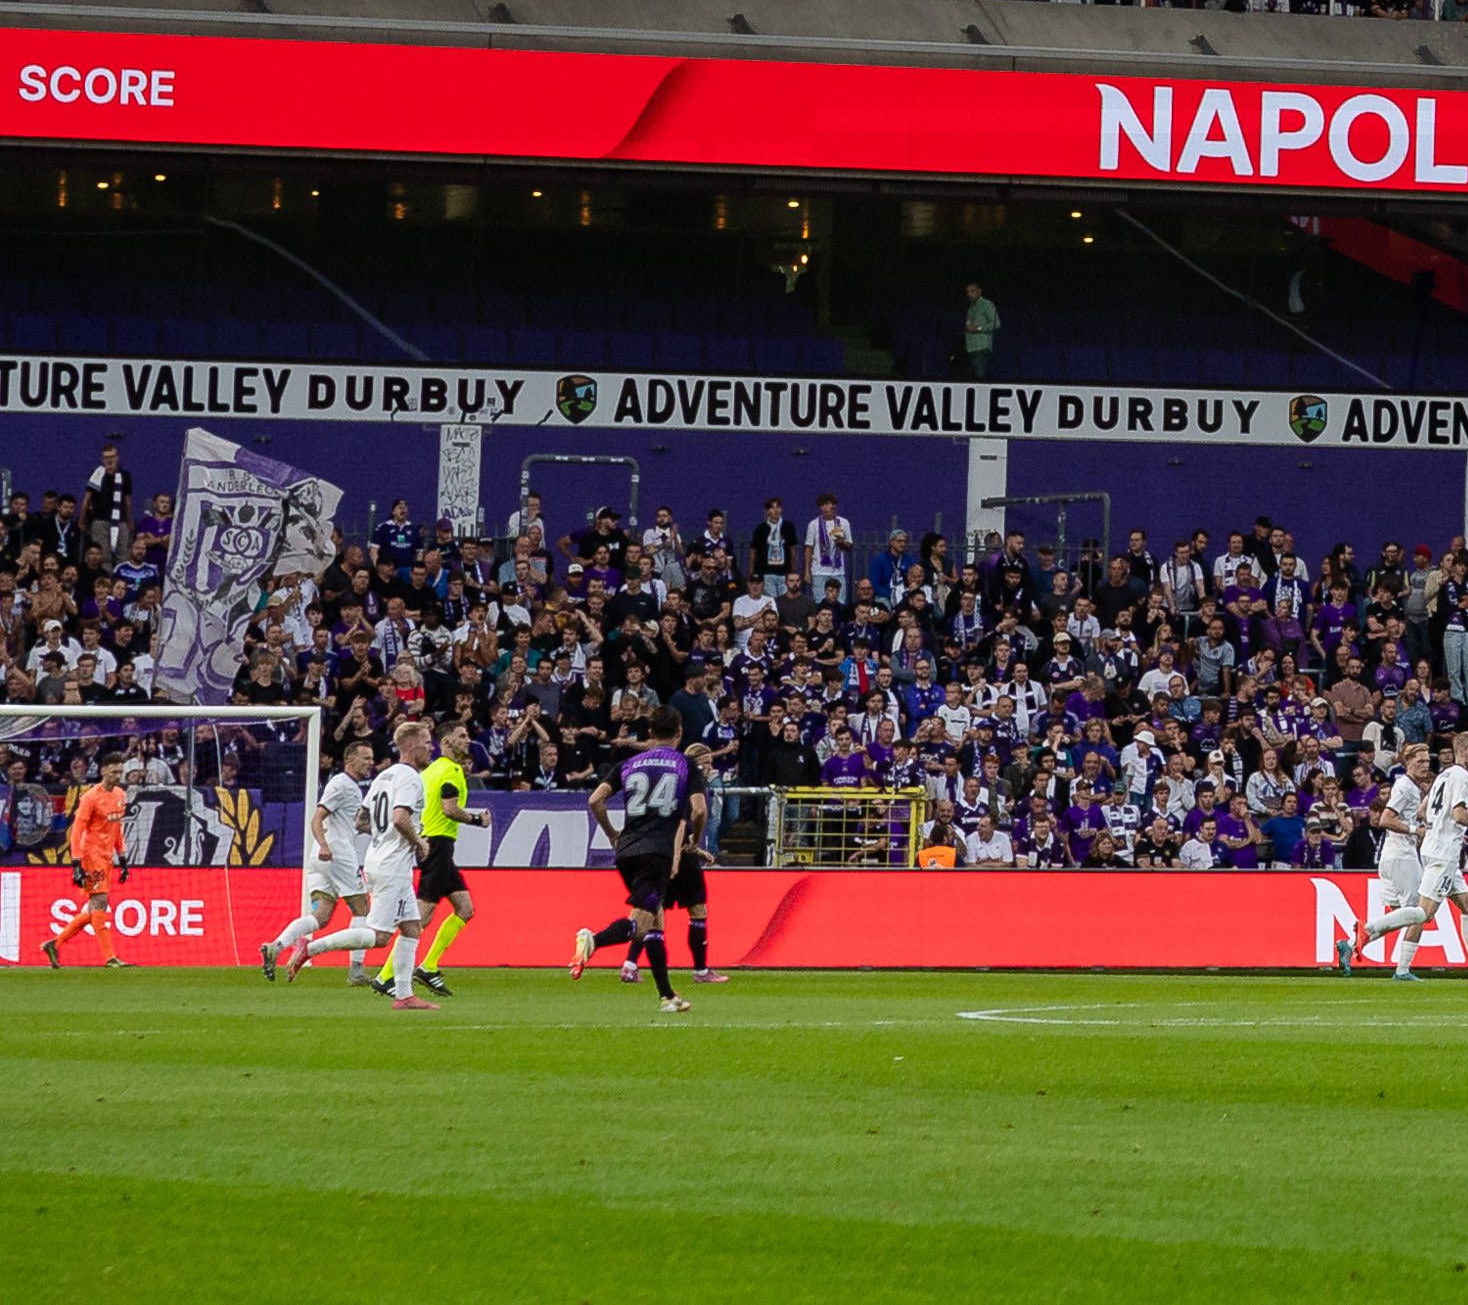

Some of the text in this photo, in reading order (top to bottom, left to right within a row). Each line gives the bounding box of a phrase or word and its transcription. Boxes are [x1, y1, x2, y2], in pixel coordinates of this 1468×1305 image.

[19, 65, 176, 108] SCORE
[123, 364, 291, 414] VALLEY
[308, 374, 525, 415] DURBUY
[615, 378, 1260, 434] ADVENTURE VALLEY DURBUY
[372, 791, 389, 833] 10
[625, 772, 680, 818] 24
